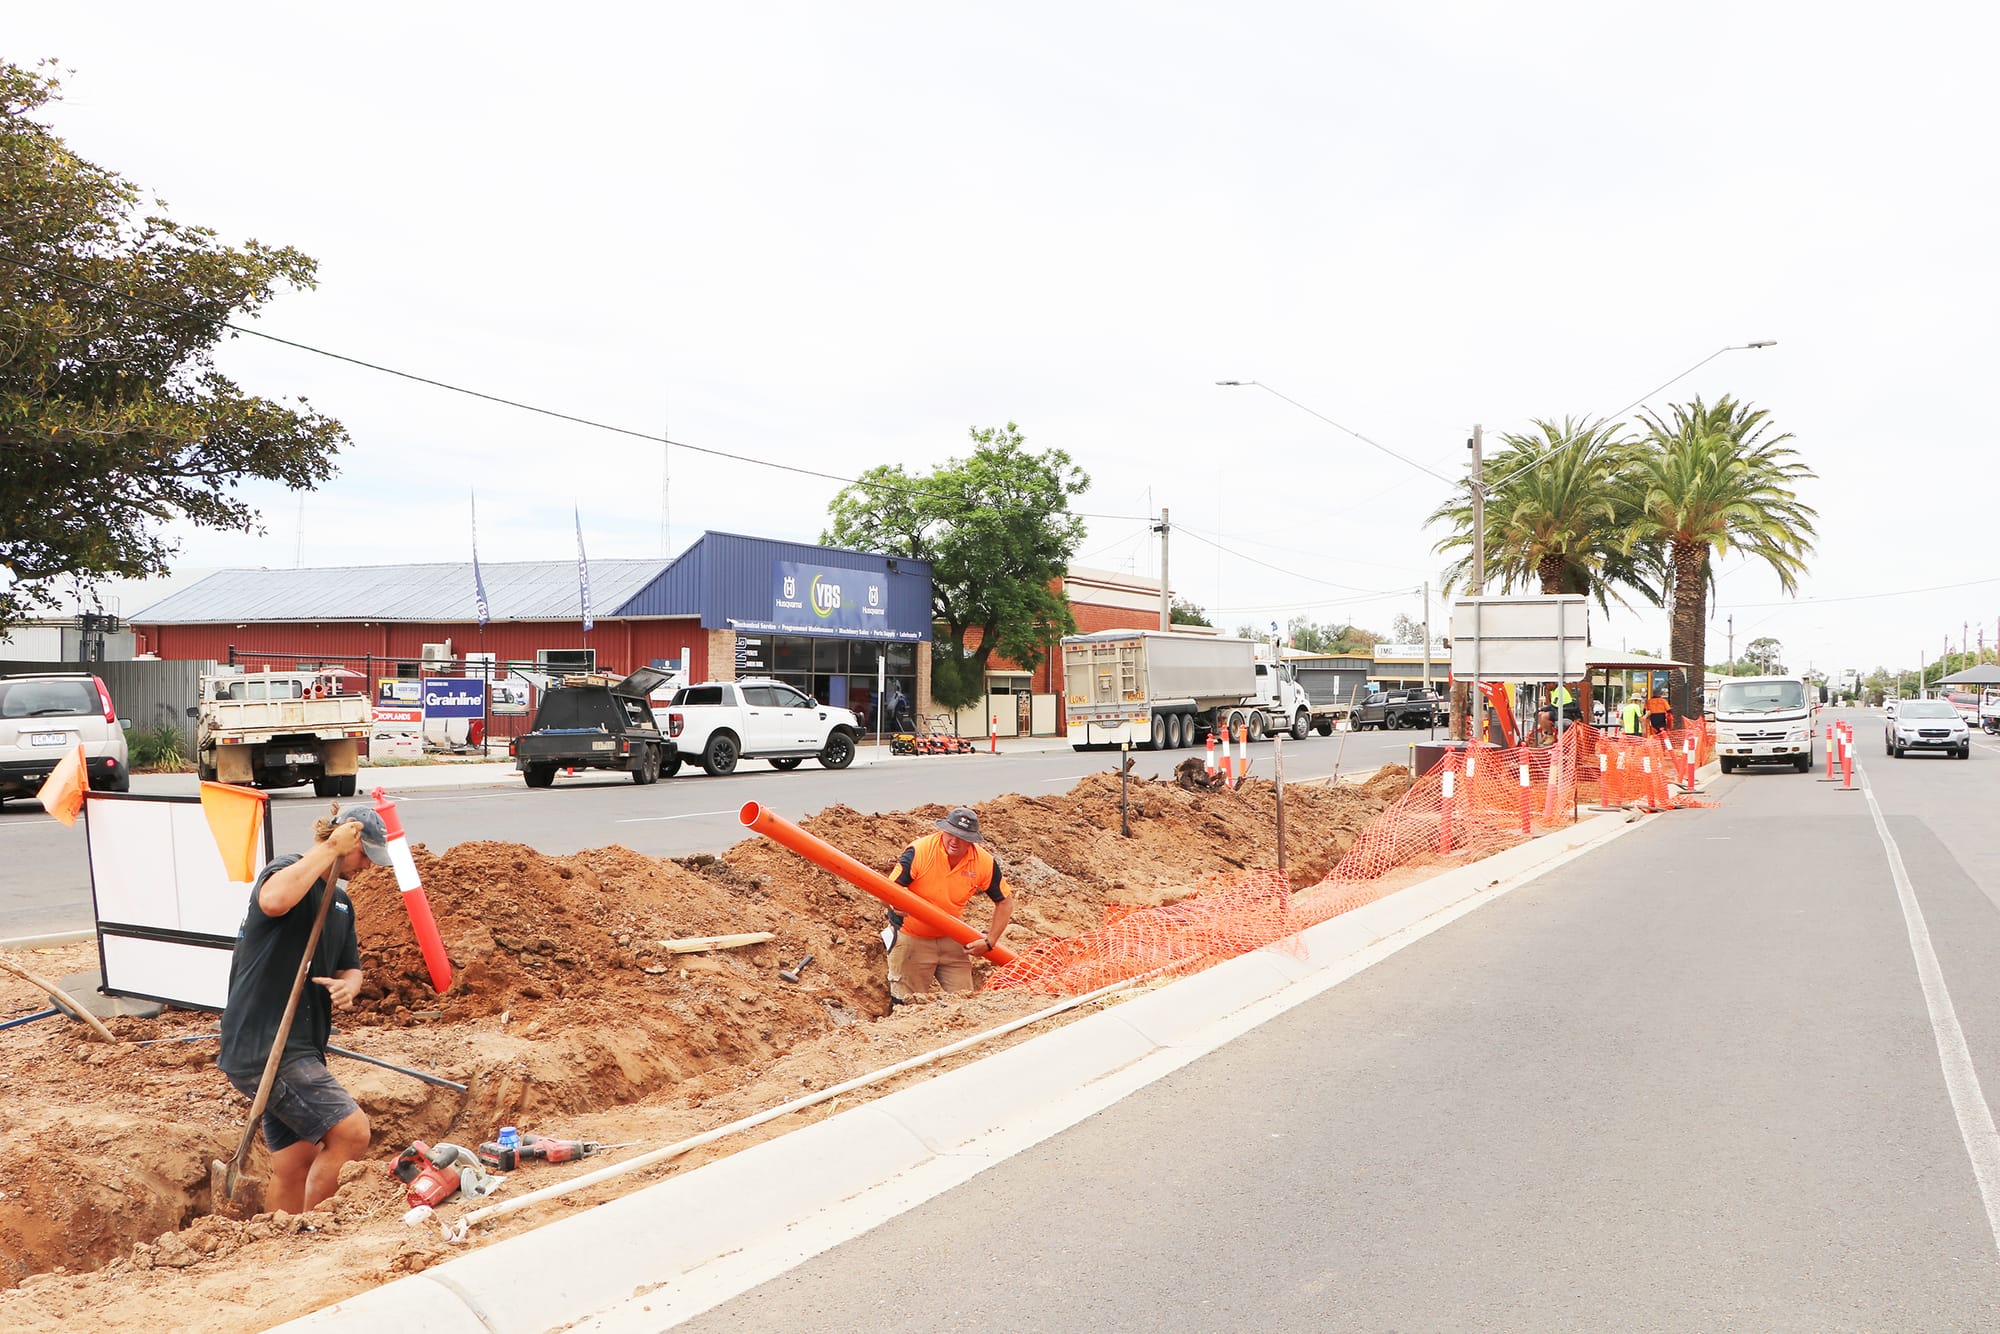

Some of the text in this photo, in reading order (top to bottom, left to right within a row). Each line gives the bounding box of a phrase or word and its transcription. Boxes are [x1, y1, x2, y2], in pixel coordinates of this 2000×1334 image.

[816, 583, 840, 608] YBS
[776, 599, 802, 609] Husqvarna
[862, 606, 884, 615] Husqvarna
[427, 691, 481, 706] Grainline
[1072, 695, 1087, 703] LONG
